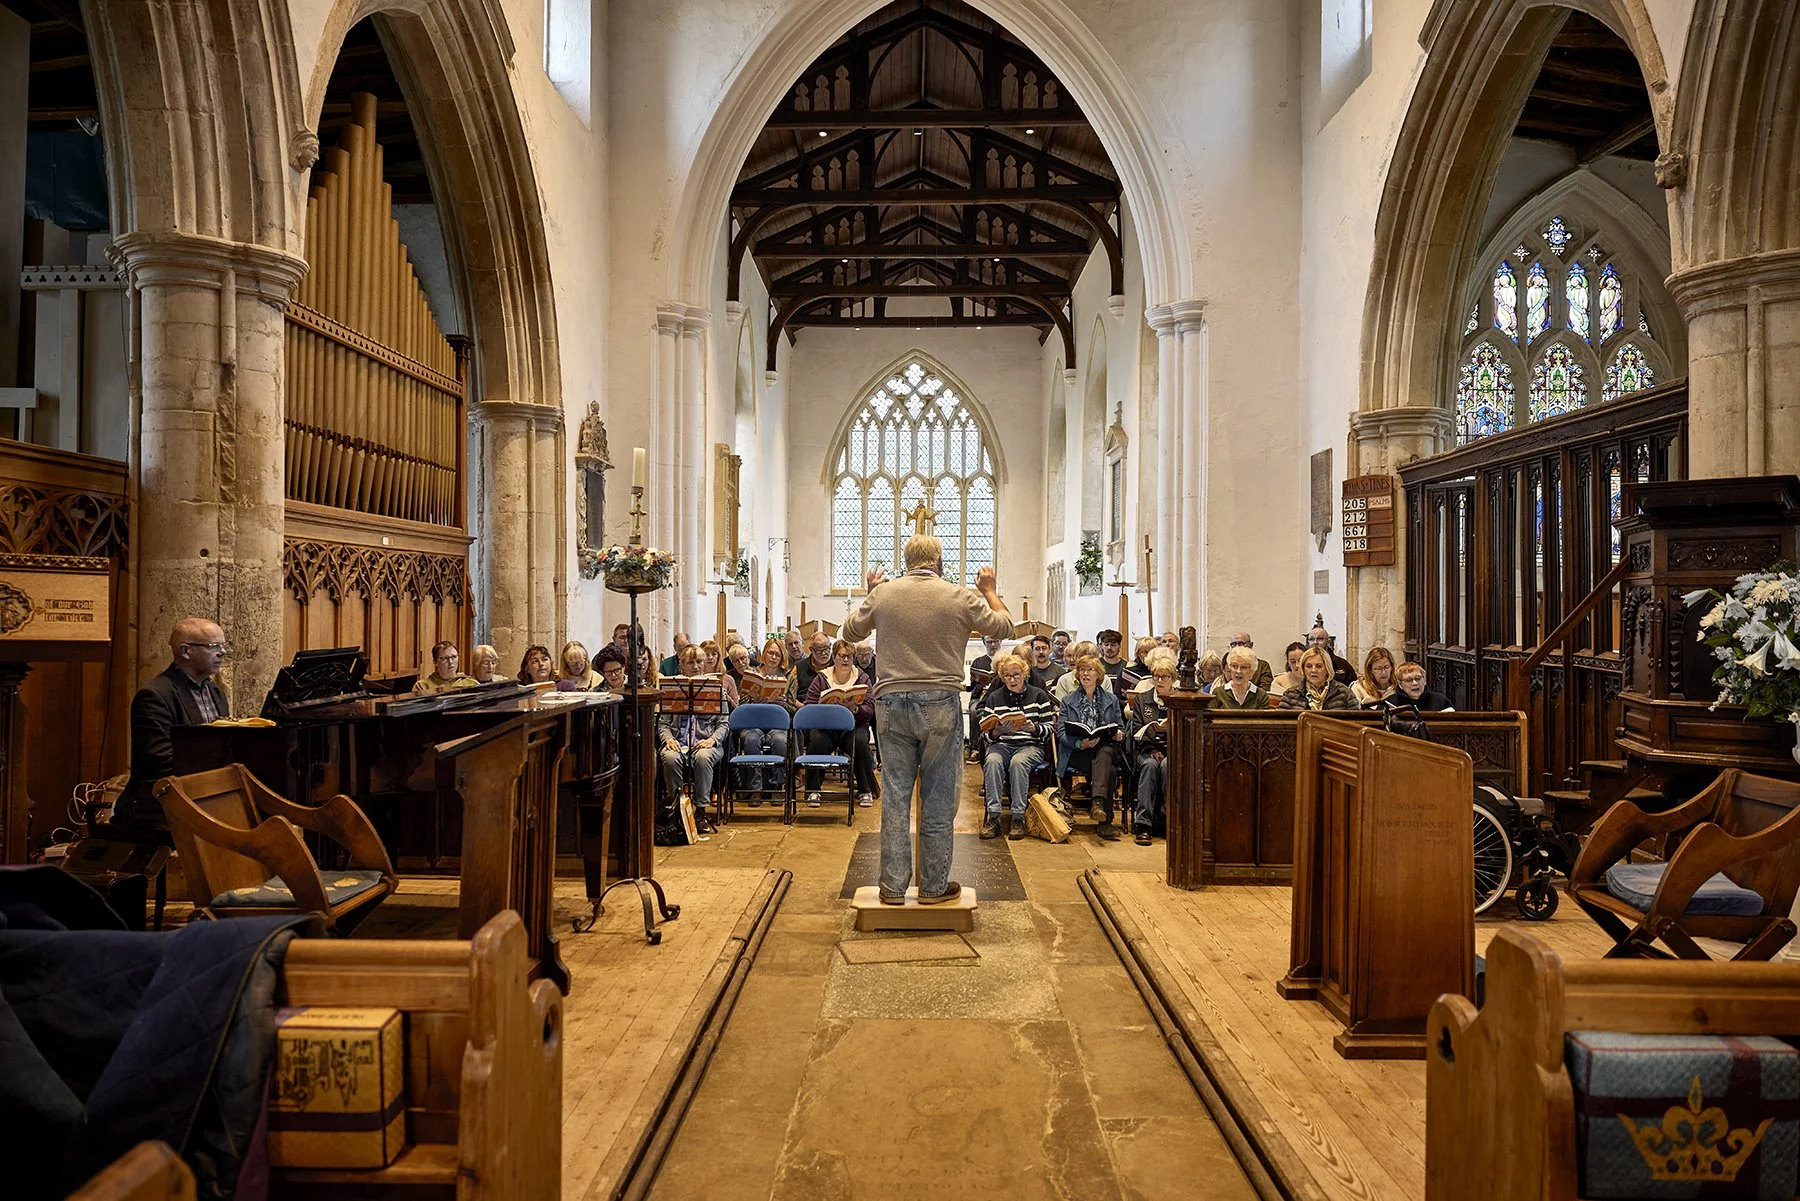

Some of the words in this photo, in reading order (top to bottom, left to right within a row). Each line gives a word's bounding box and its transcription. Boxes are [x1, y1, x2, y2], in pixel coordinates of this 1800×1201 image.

[1344, 499, 1366, 510] 205
[1344, 512, 1366, 523] 212
[1344, 525, 1366, 537] 667
[1345, 538, 1366, 550] 218
